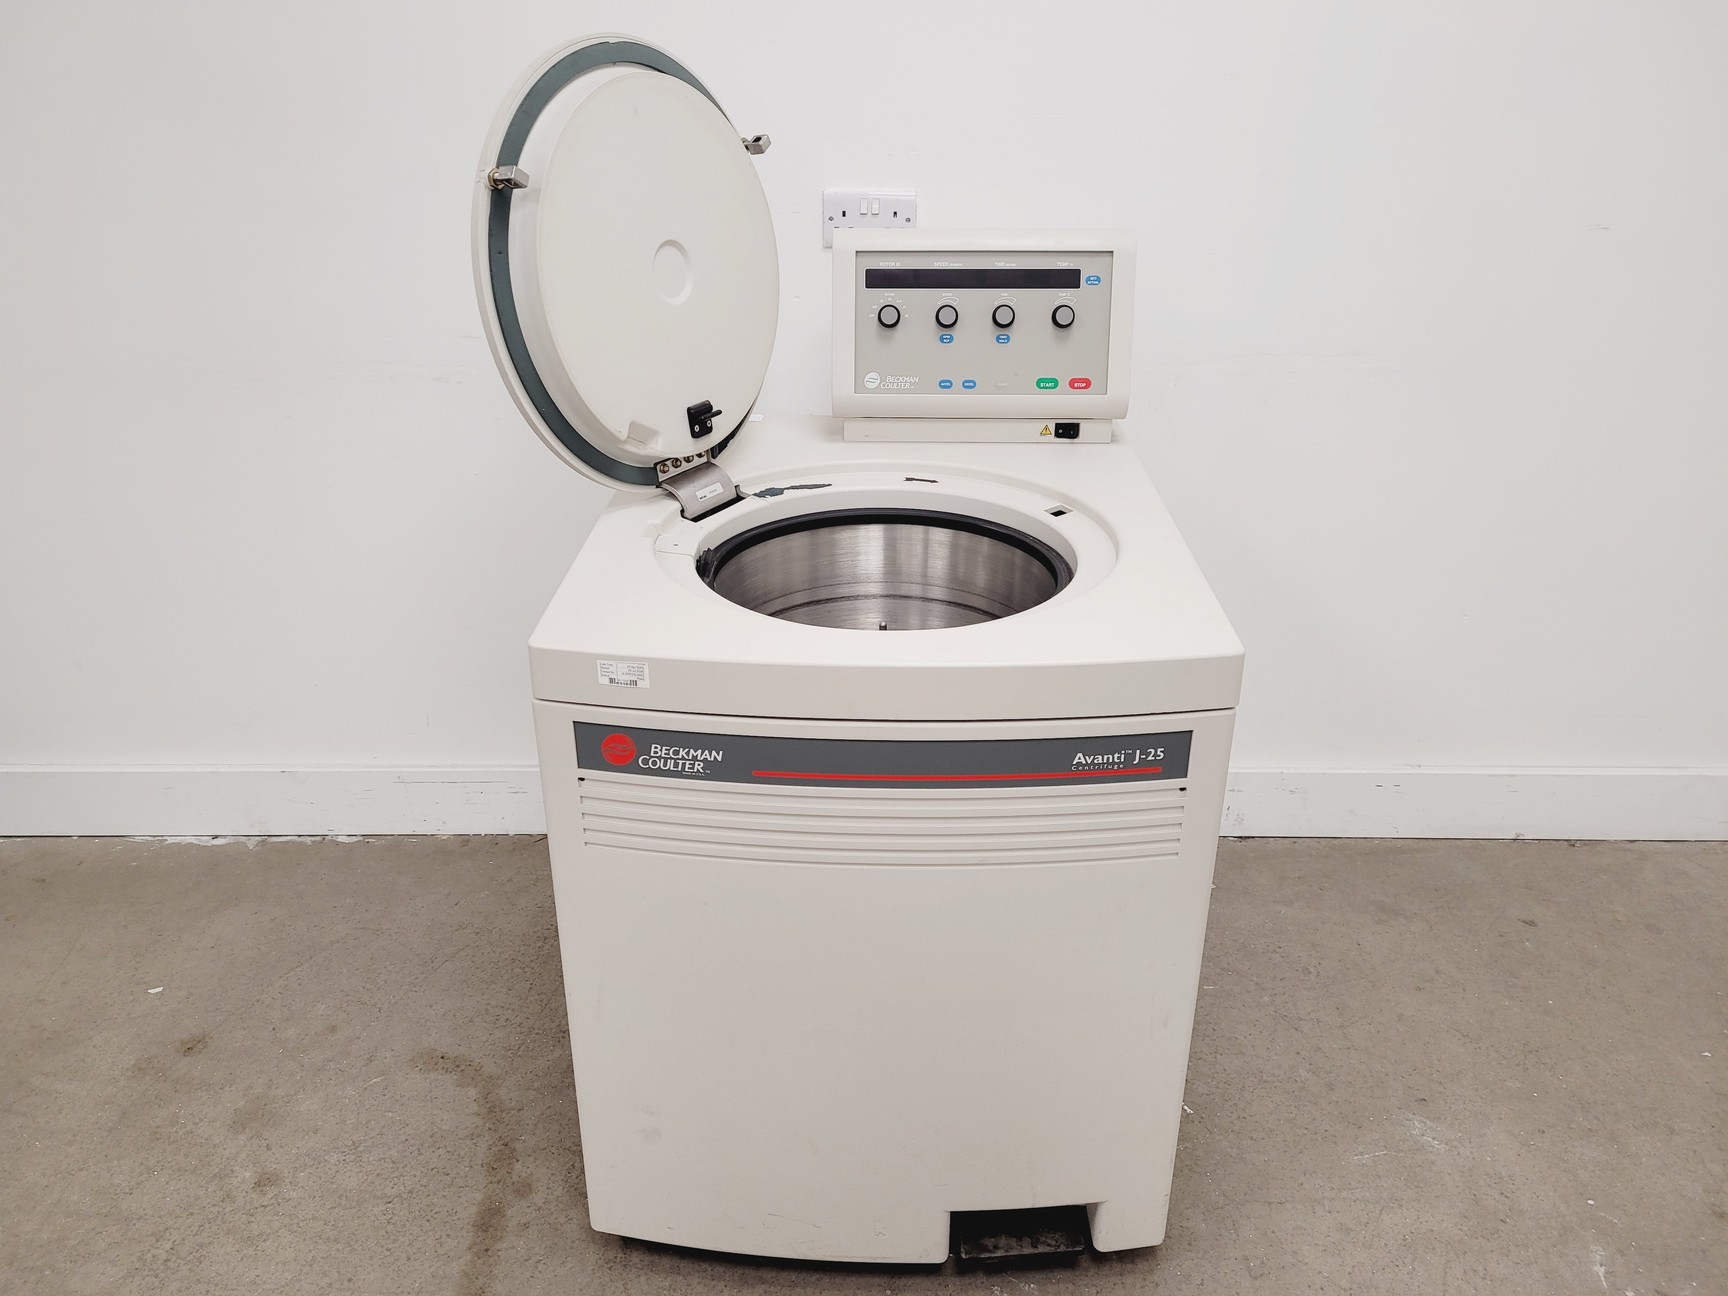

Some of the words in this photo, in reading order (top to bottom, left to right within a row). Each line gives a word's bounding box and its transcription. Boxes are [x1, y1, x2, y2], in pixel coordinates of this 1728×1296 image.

[886, 375, 919, 383] BECKMAN
[650, 743, 723, 762] BECKMAN
[1133, 747, 1165, 764] J-25
[1071, 763, 1124, 771] Centrifuge
